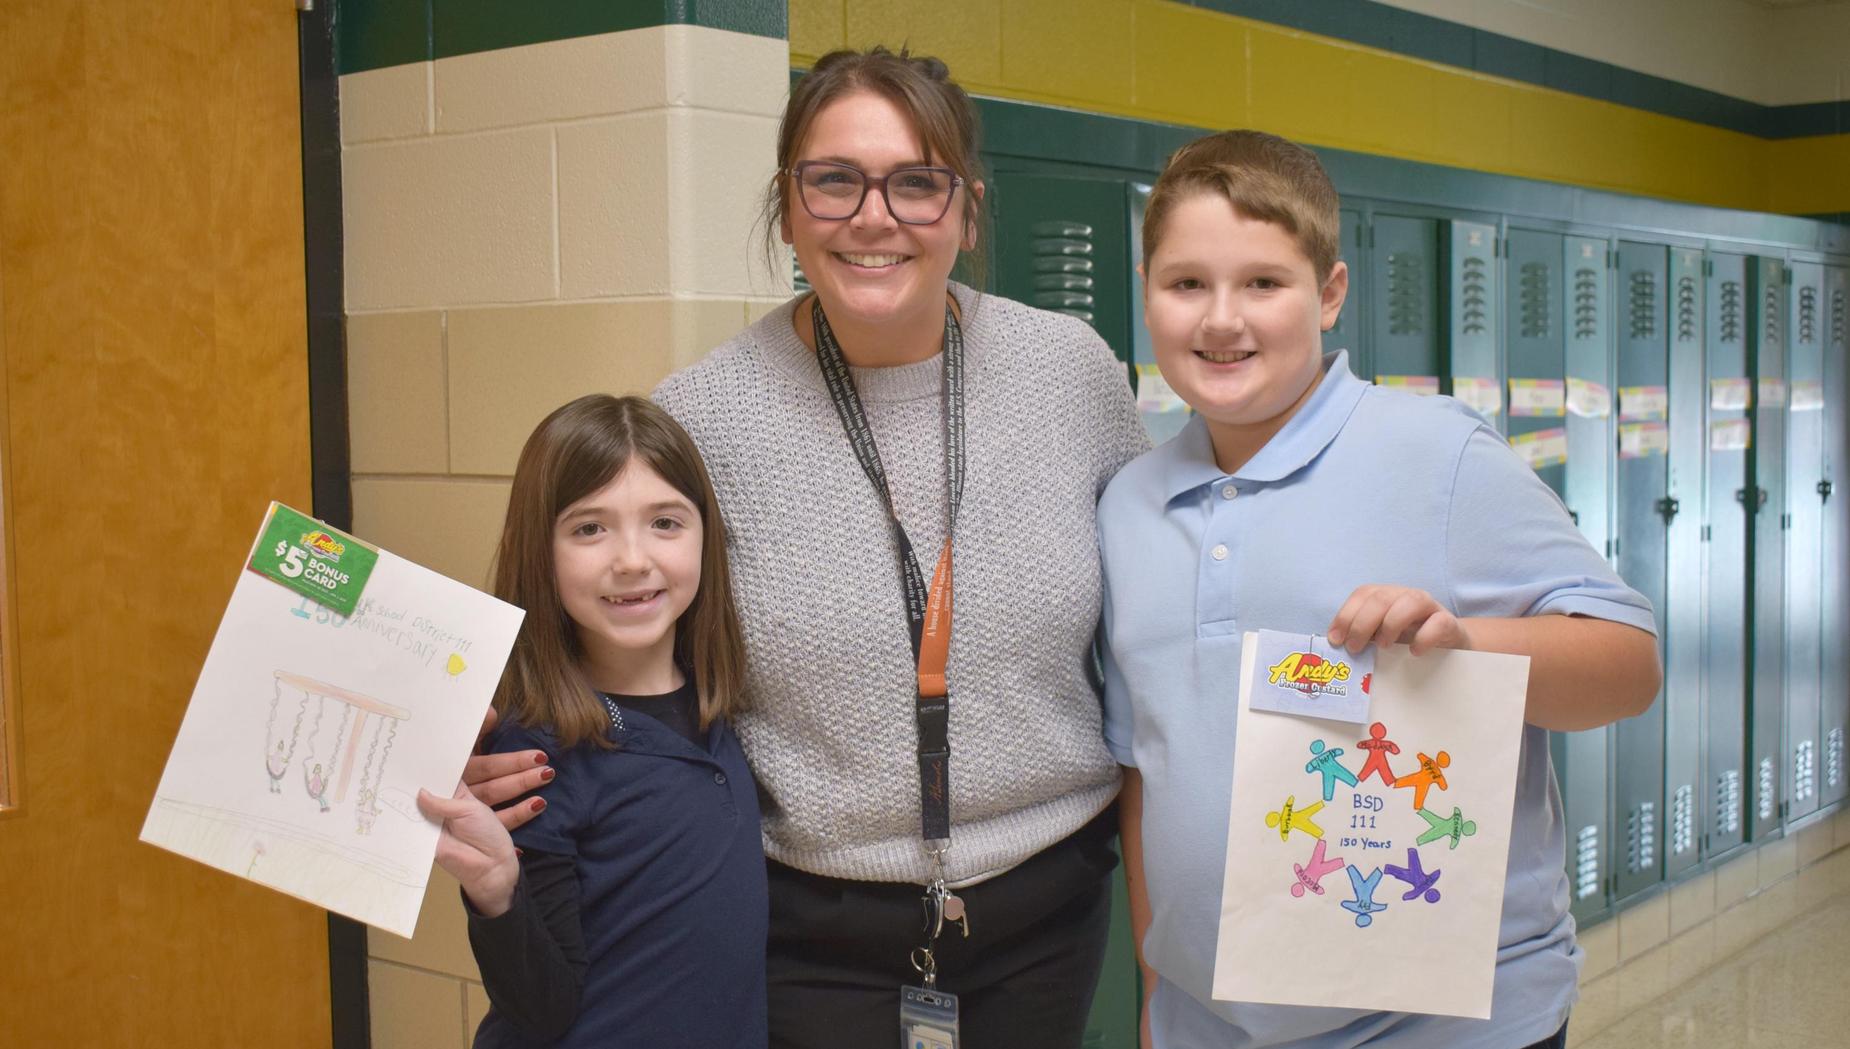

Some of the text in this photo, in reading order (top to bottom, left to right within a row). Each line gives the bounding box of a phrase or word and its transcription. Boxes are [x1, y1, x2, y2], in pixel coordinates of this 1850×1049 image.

[841, 376, 854, 395] United
[848, 394, 860, 413] States
[831, 379, 839, 392] role
[837, 399, 854, 430] preserving
[854, 438, 866, 456] Union
[854, 412, 866, 428] from
[860, 427, 871, 443] 1861
[865, 443, 875, 458] until
[275, 540, 308, 578] $5
[903, 560, 911, 573] with
[908, 550, 916, 565] With
[304, 568, 336, 589] CARD
[309, 558, 350, 584] BONUS
[911, 566, 922, 587] malice
[904, 575, 916, 598] charity
[909, 599, 918, 609] for
[916, 588, 927, 610] toward
[930, 586, 942, 609] divided
[927, 610, 939, 630] house
[1269, 652, 1351, 684] Andy's
[1279, 679, 1346, 696] Frozen Custard
[1310, 748, 1338, 769] Liberty
[1354, 794, 1384, 811] BSD
[1350, 815, 1376, 829] 111
[1340, 837, 1391, 850] 150 Years
[1358, 902, 1371, 910] Fry
